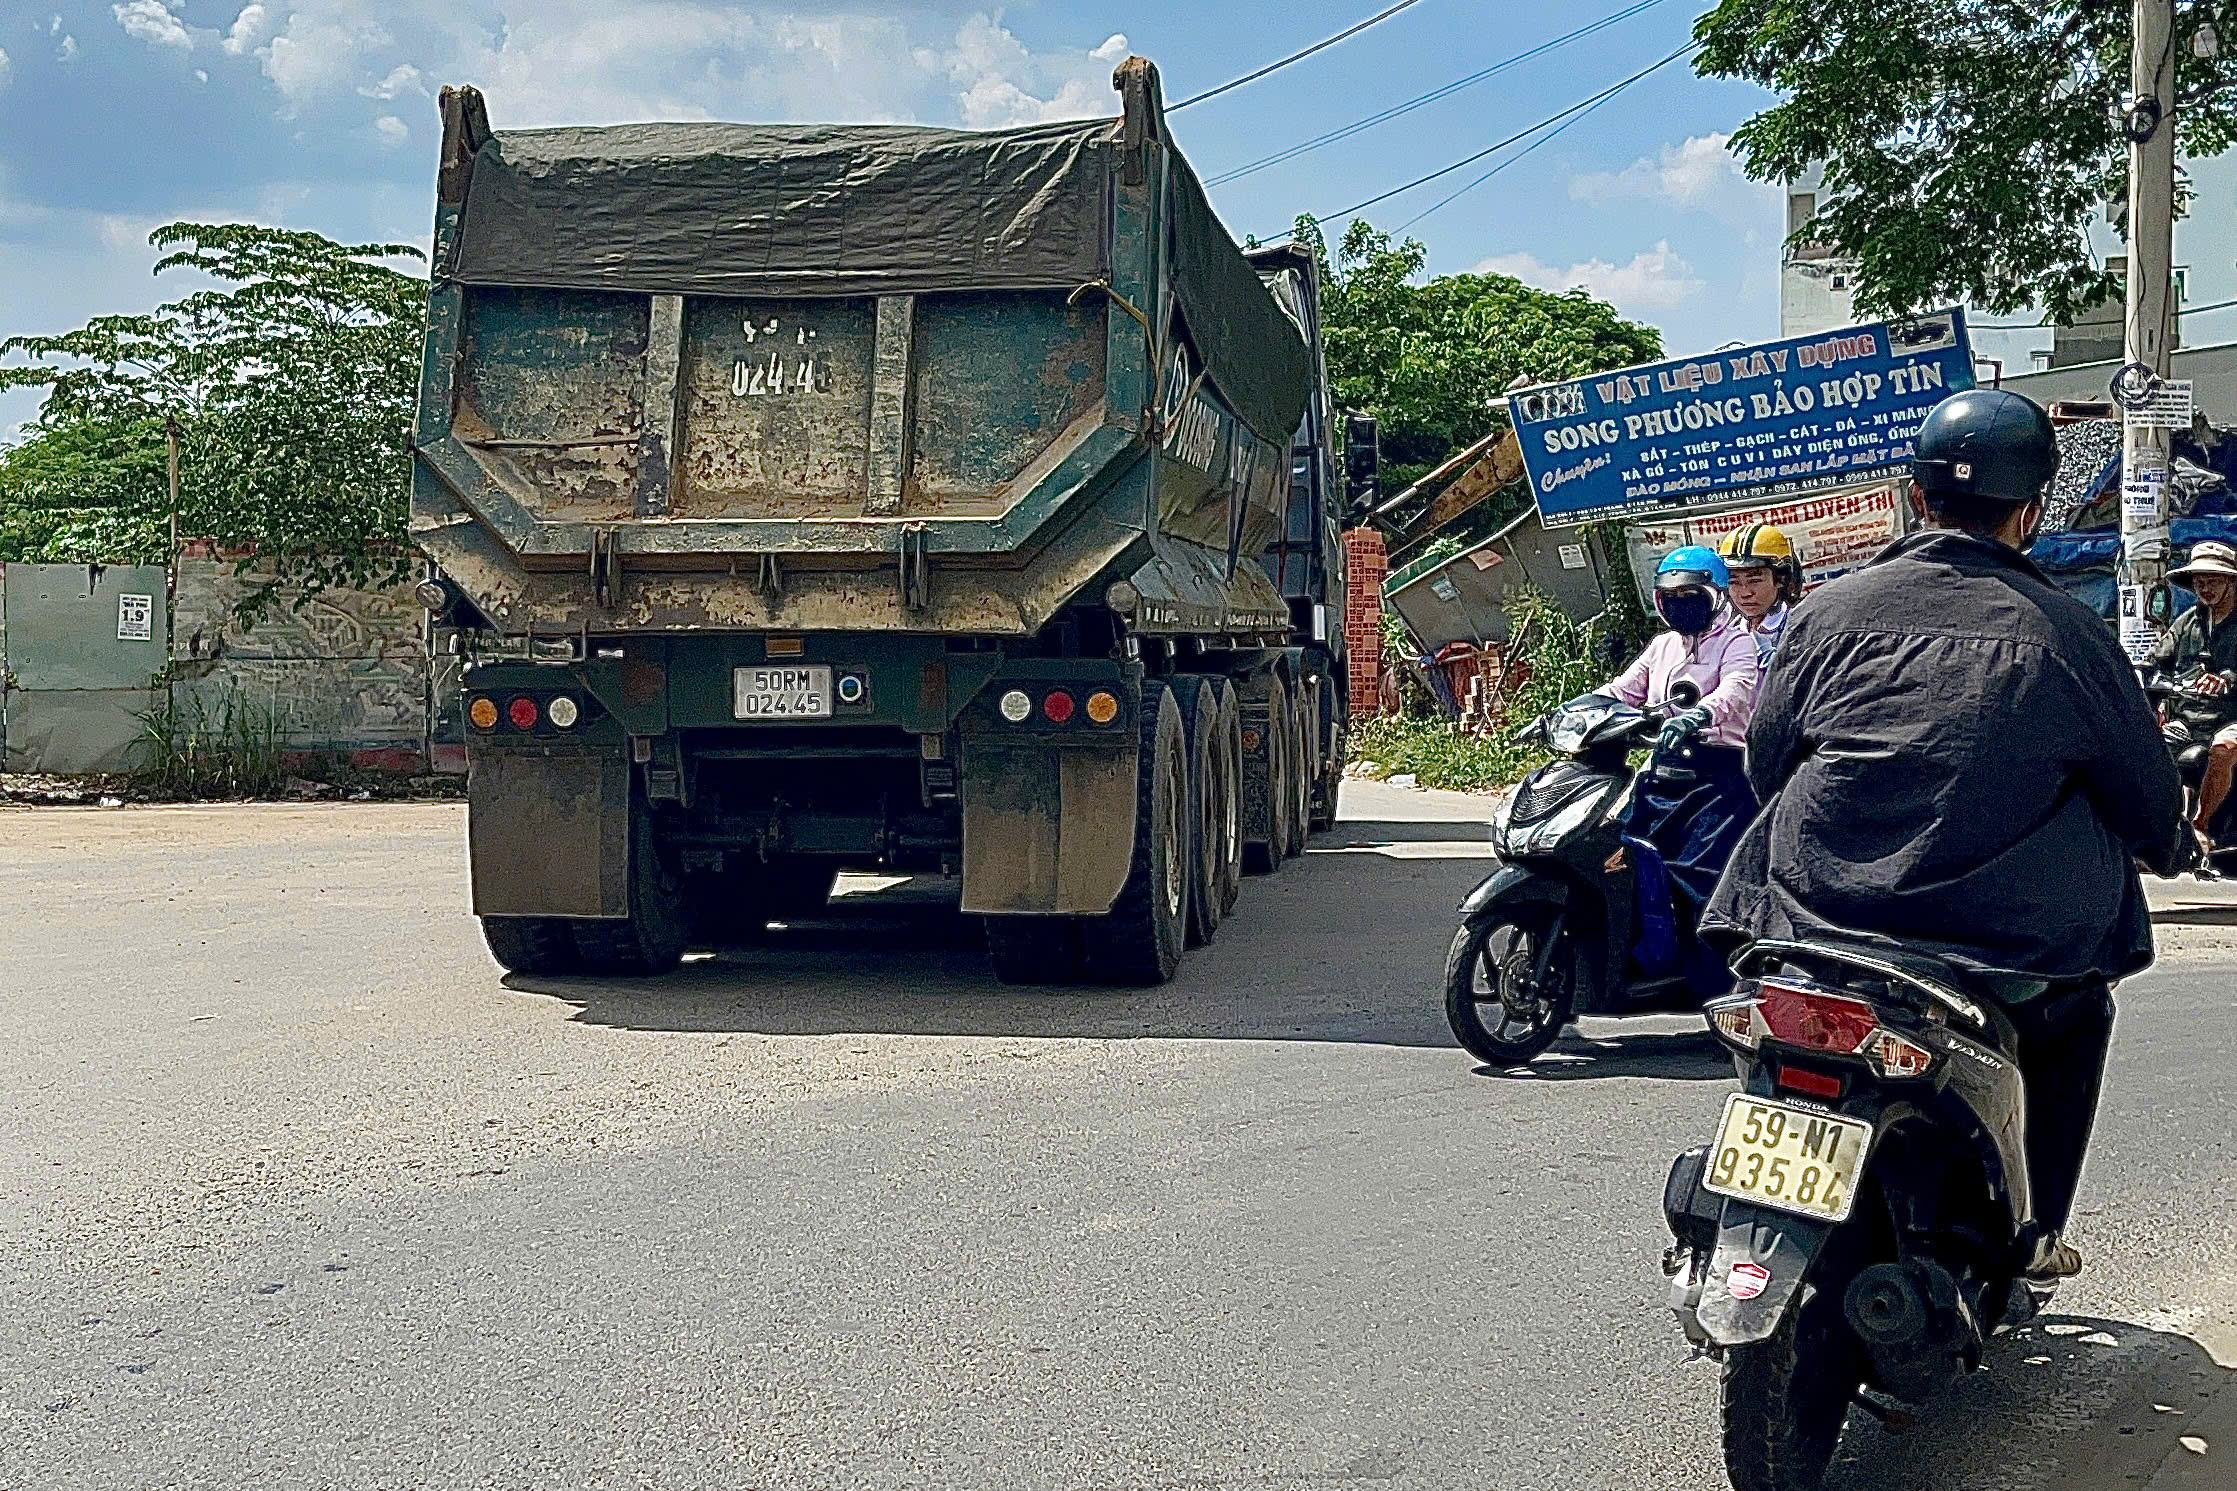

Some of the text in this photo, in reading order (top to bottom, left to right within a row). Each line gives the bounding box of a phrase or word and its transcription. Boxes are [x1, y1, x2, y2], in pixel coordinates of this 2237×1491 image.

[1596, 334, 1876, 404] VẬT LIỆU XÂY DỰNG
[1544, 358, 1944, 453] SONG PHƯƠNG BẢO HỢP TÍN
[1683, 440, 1721, 456] THÉP
[1736, 432, 1775, 448] GẠCH
[1790, 424, 1819, 440] CÁT
[1873, 412, 1889, 426] XI
[1621, 467, 1642, 482] XÀ
[1680, 458, 1709, 473] TÔN
[1779, 461, 1813, 476] SAN
[1804, 494, 1861, 521] LUYỆN
[1867, 489, 1895, 511] THI
[755, 670, 811, 692] 50RM
[746, 693, 821, 714] 024.45
[1742, 1107, 1844, 1164] 59-N1
[1715, 1147, 1841, 1213] 935.84
